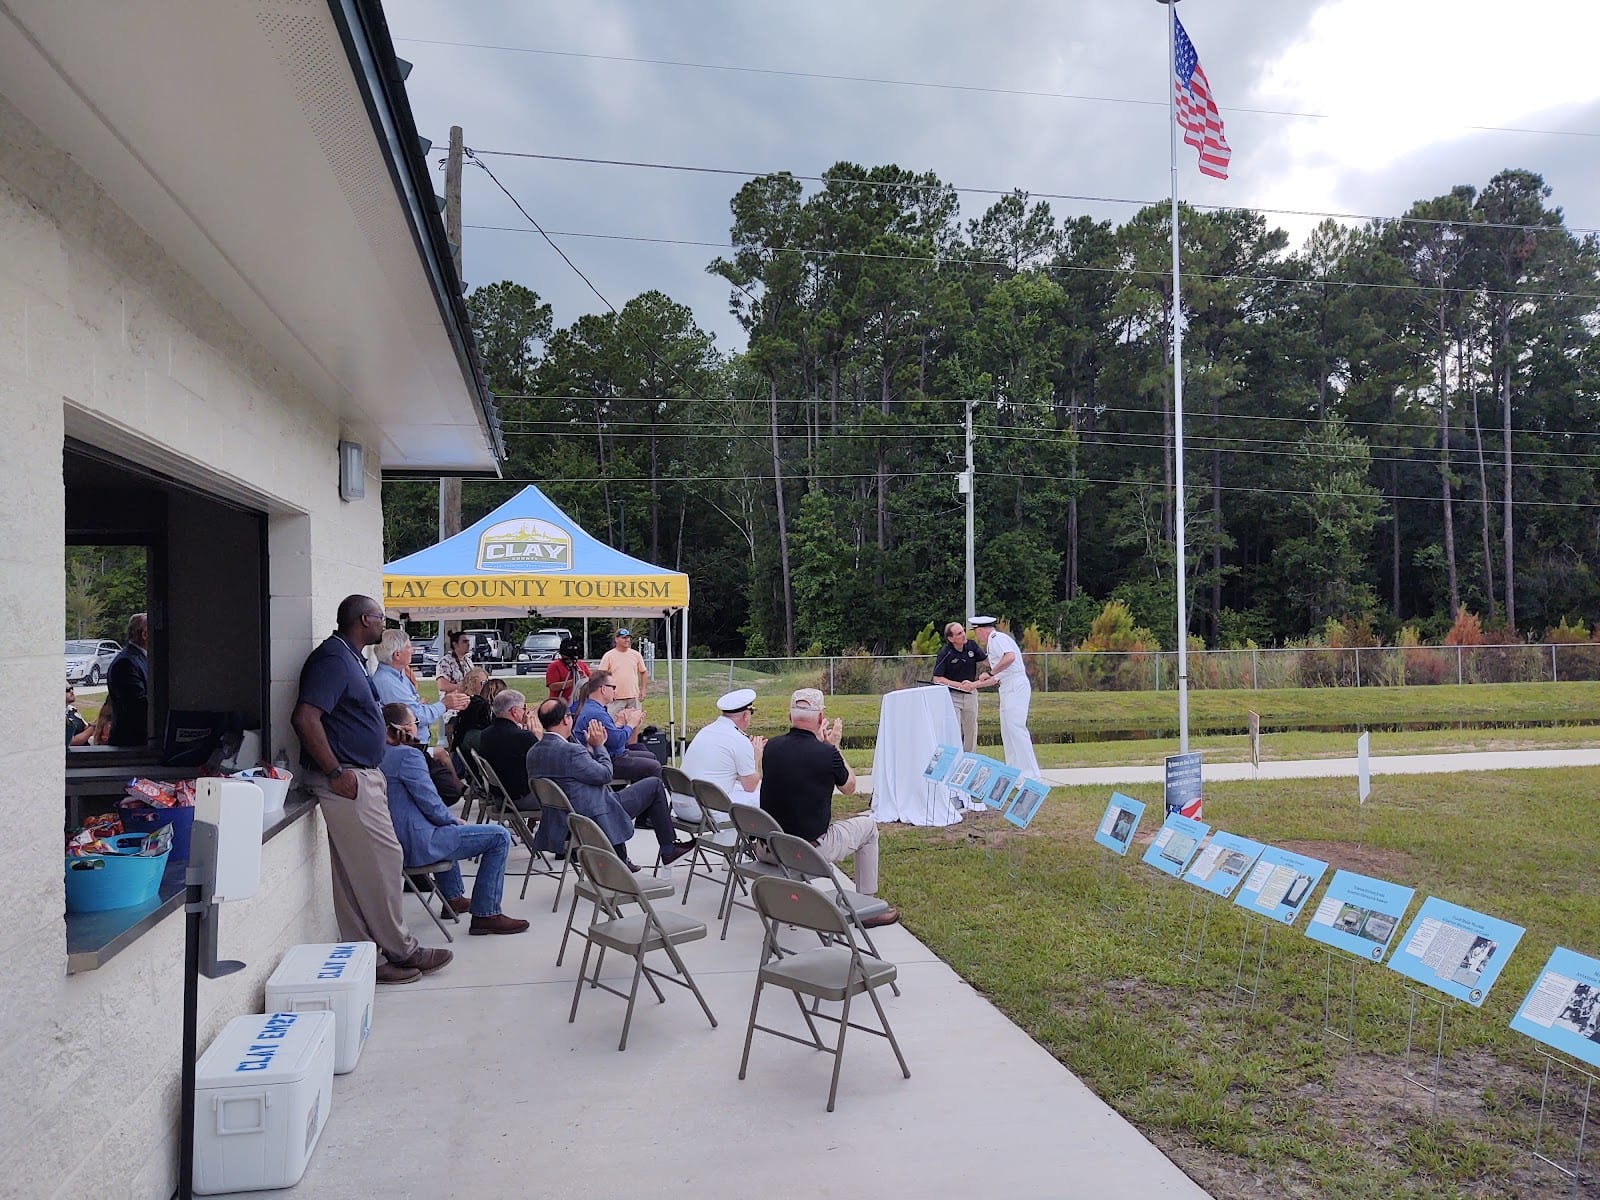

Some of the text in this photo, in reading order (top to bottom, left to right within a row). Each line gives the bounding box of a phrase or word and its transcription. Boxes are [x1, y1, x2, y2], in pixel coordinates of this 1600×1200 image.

[486, 543, 566, 560] CLAY
[383, 580, 671, 598] LAY COUNTY TOURISM
[317, 961, 347, 979] CLAY
[236, 1045, 280, 1072] CLAY
